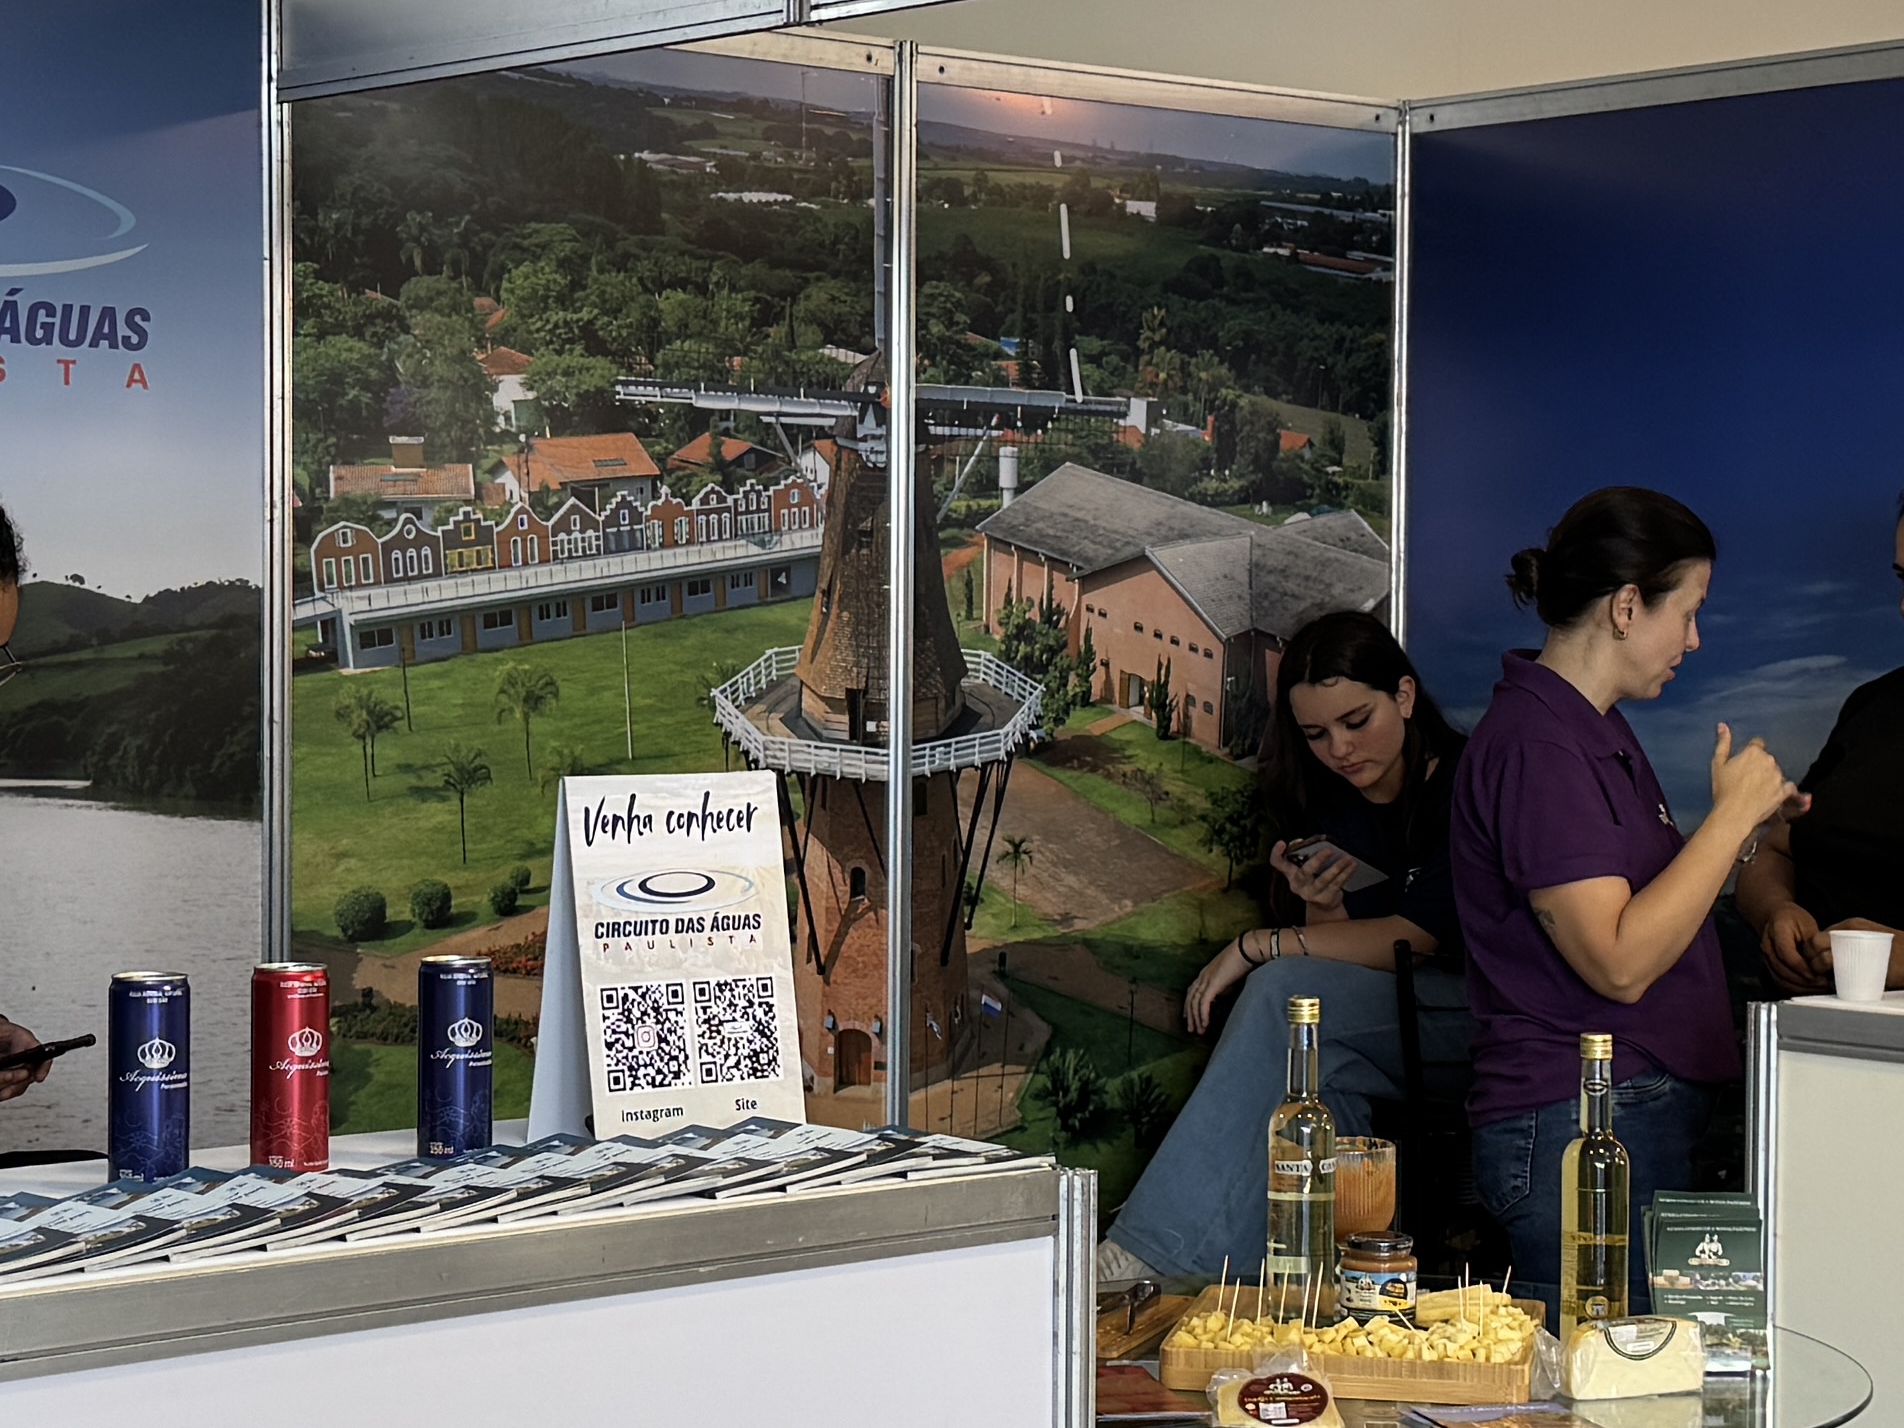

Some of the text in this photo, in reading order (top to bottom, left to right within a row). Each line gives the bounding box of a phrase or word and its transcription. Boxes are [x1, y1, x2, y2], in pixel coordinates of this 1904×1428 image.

[584, 790, 758, 847] Venha conhecer
[594, 911, 762, 941] CIRCUITO DAS ÁGUAS
[602, 933, 758, 953] PAULISTA
[621, 1104, 685, 1123] Instagram
[735, 1097, 758, 1113] Site
